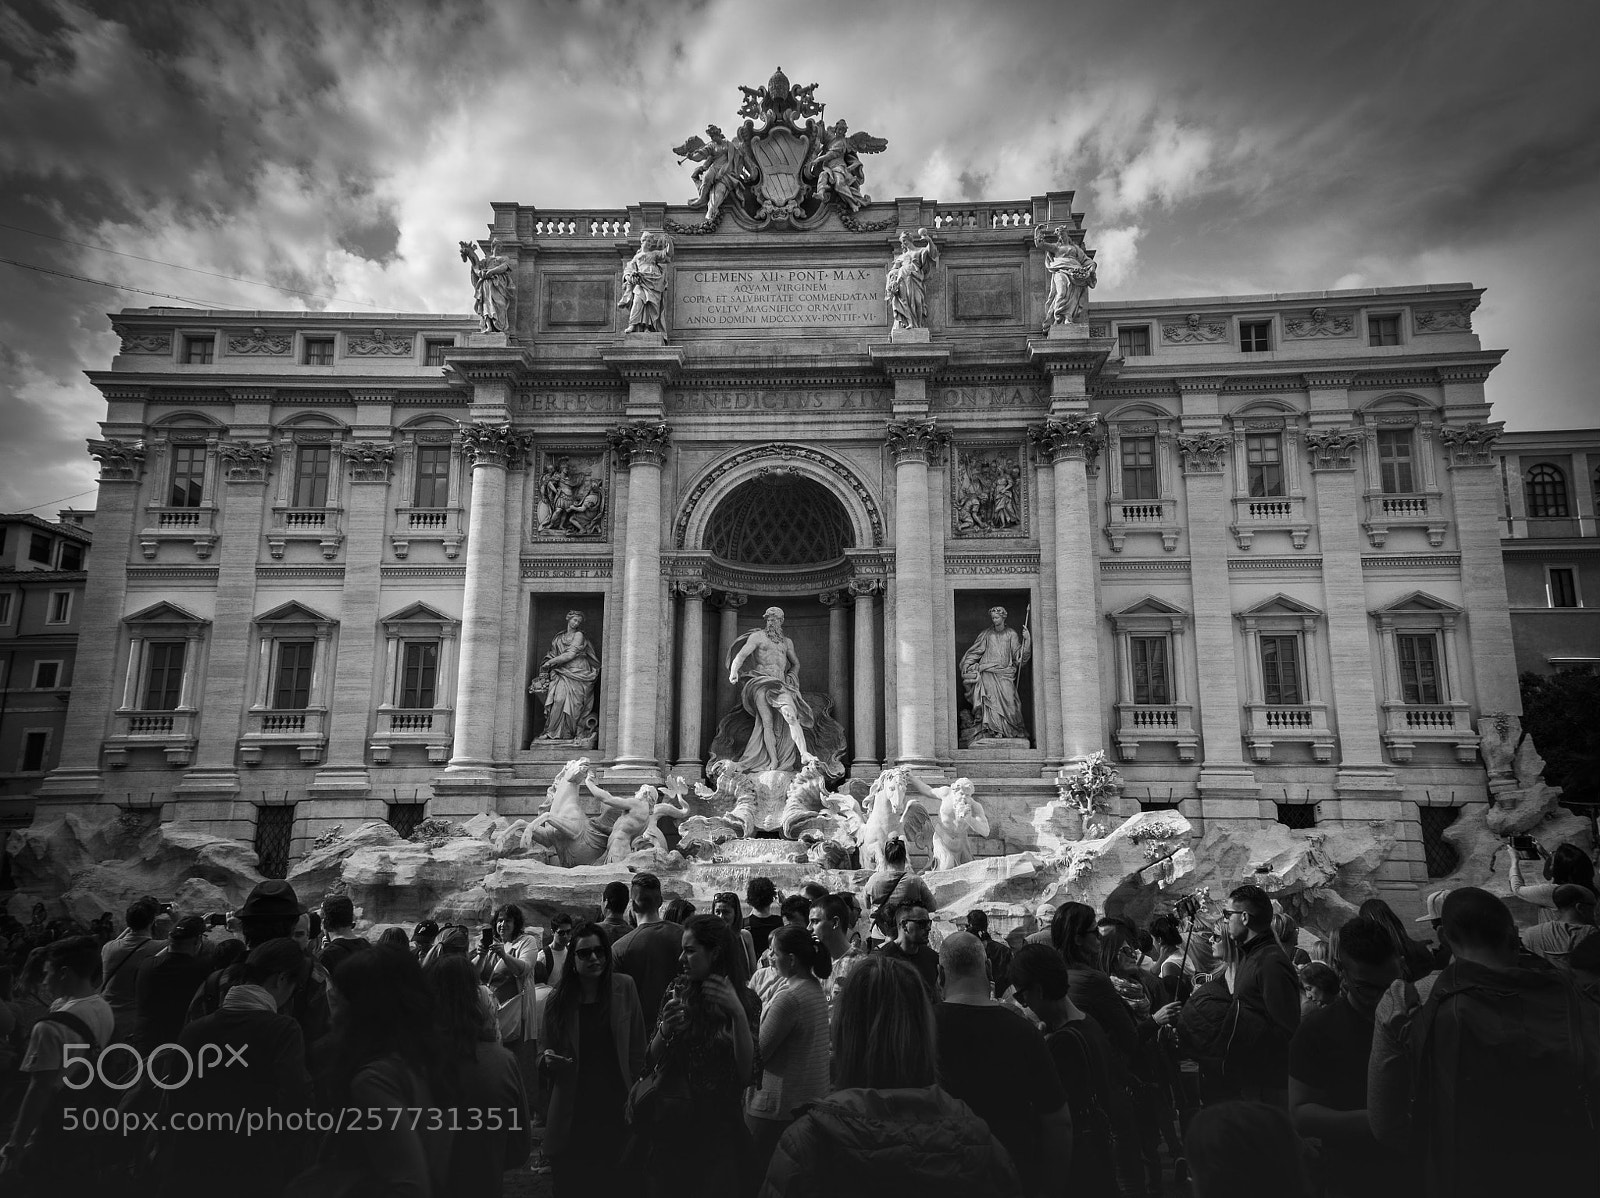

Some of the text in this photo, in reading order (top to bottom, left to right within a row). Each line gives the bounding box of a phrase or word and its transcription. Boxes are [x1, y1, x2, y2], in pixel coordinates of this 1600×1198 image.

[694, 272, 754, 283] CLEMENS
[733, 283, 827, 294] AQVAM VIRGINEM
[682, 292, 877, 303] COPIA ET SALVBRITATE COMMENDATAM
[707, 303, 854, 313] CVLTV MAGNIFICO ORNAVIT
[686, 315, 716, 324] ANNO
[719, 315, 756, 324] DOMINI
[519, 393, 627, 410] PERFECIT
[674, 392, 824, 410] BENEDICTVS
[580, 570, 589, 578] ET
